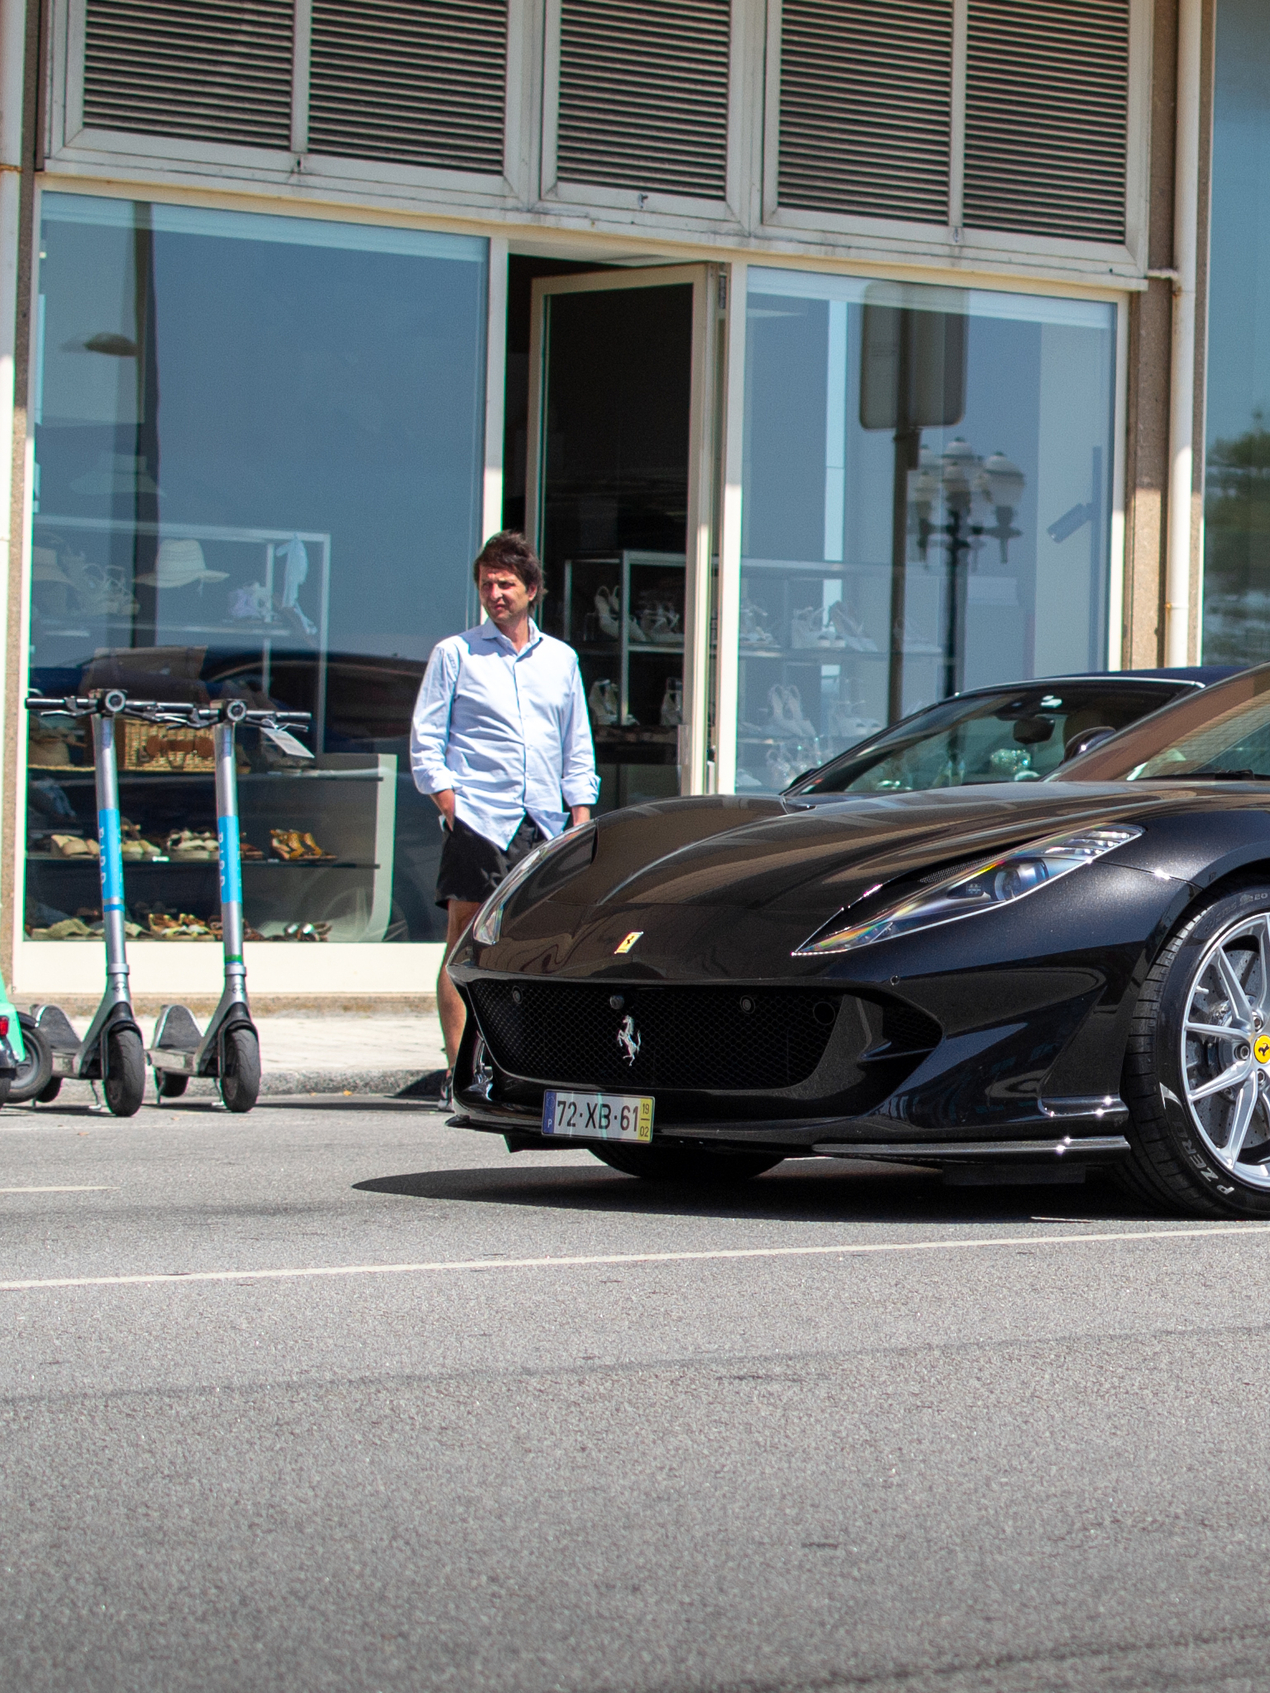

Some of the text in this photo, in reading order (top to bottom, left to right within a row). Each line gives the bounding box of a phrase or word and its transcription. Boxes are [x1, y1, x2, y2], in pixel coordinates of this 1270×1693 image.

[642, 1103, 650, 1115] 19
[547, 1118, 553, 1128] P
[640, 1126, 649, 1138] 02
[1172, 1121, 1235, 1195] P ZERO
